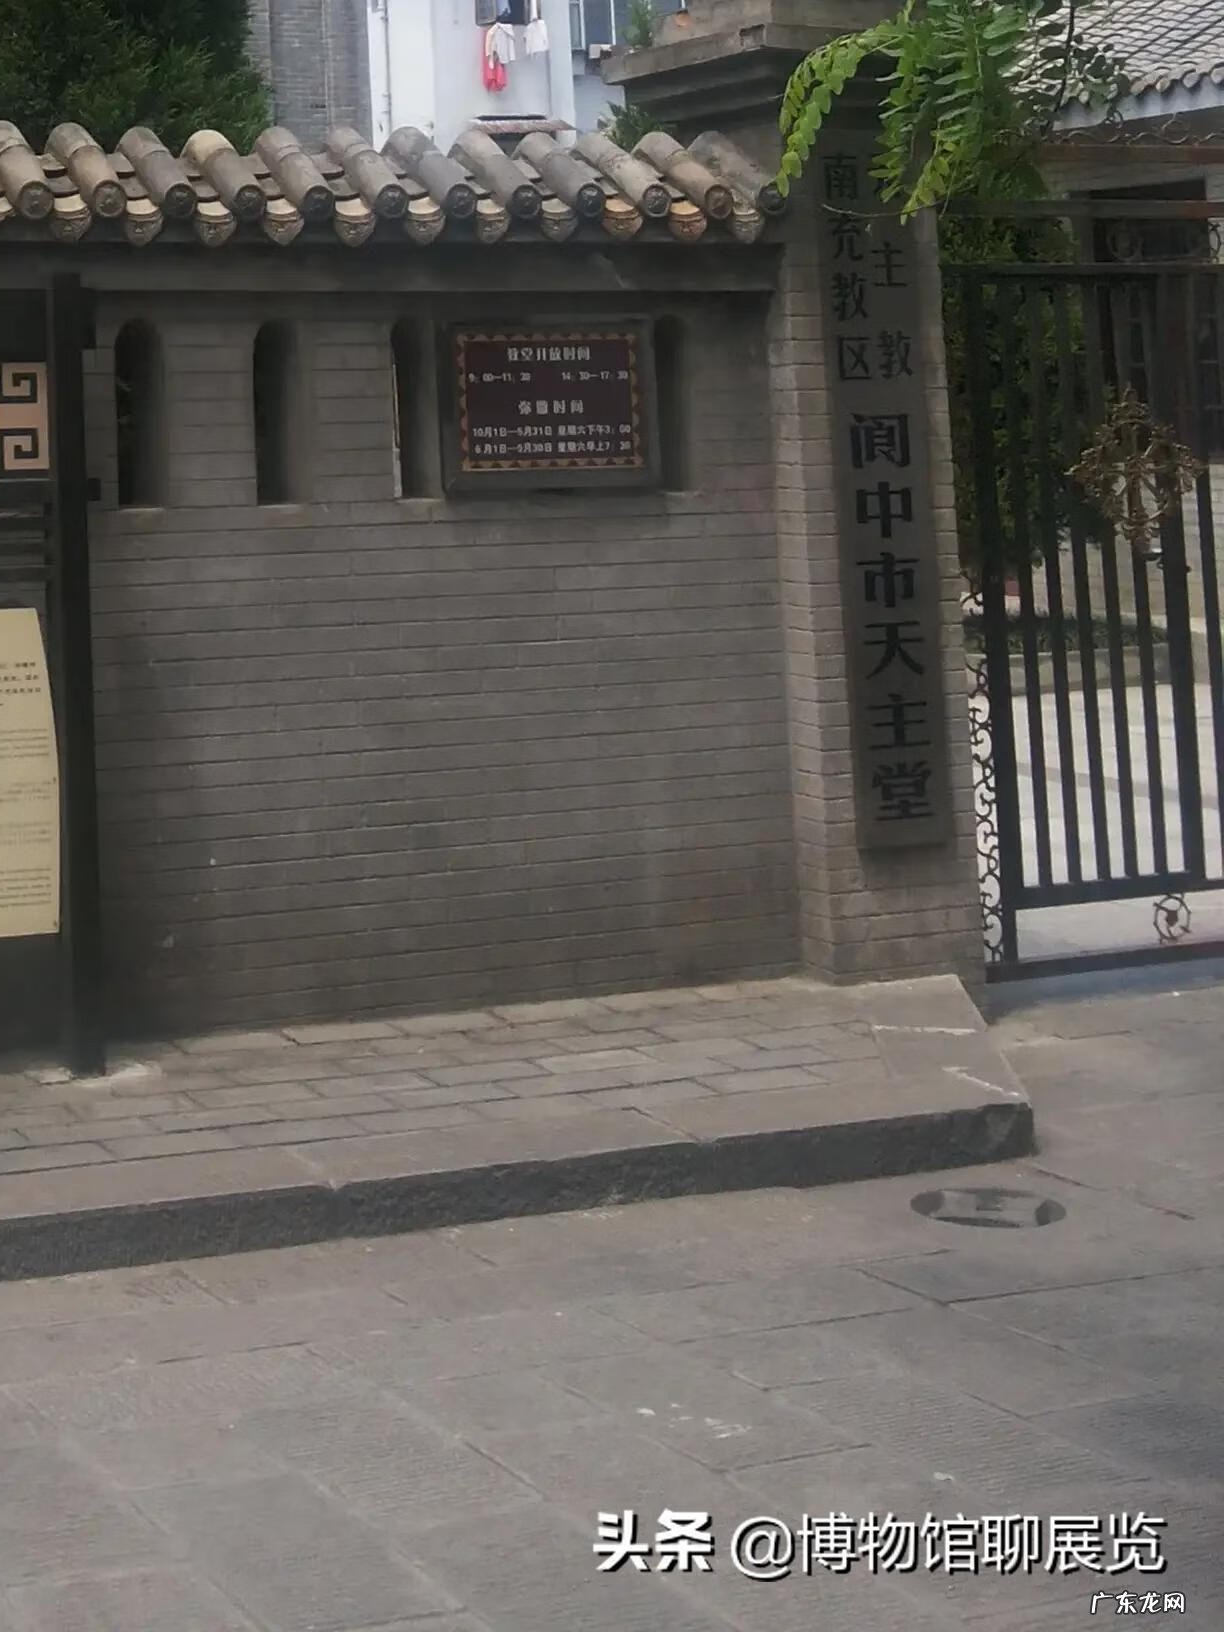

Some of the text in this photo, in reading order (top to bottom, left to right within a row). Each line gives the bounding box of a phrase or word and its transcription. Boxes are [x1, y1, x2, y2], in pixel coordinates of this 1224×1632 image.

[848, 412, 936, 823] 阆中市天主堂
